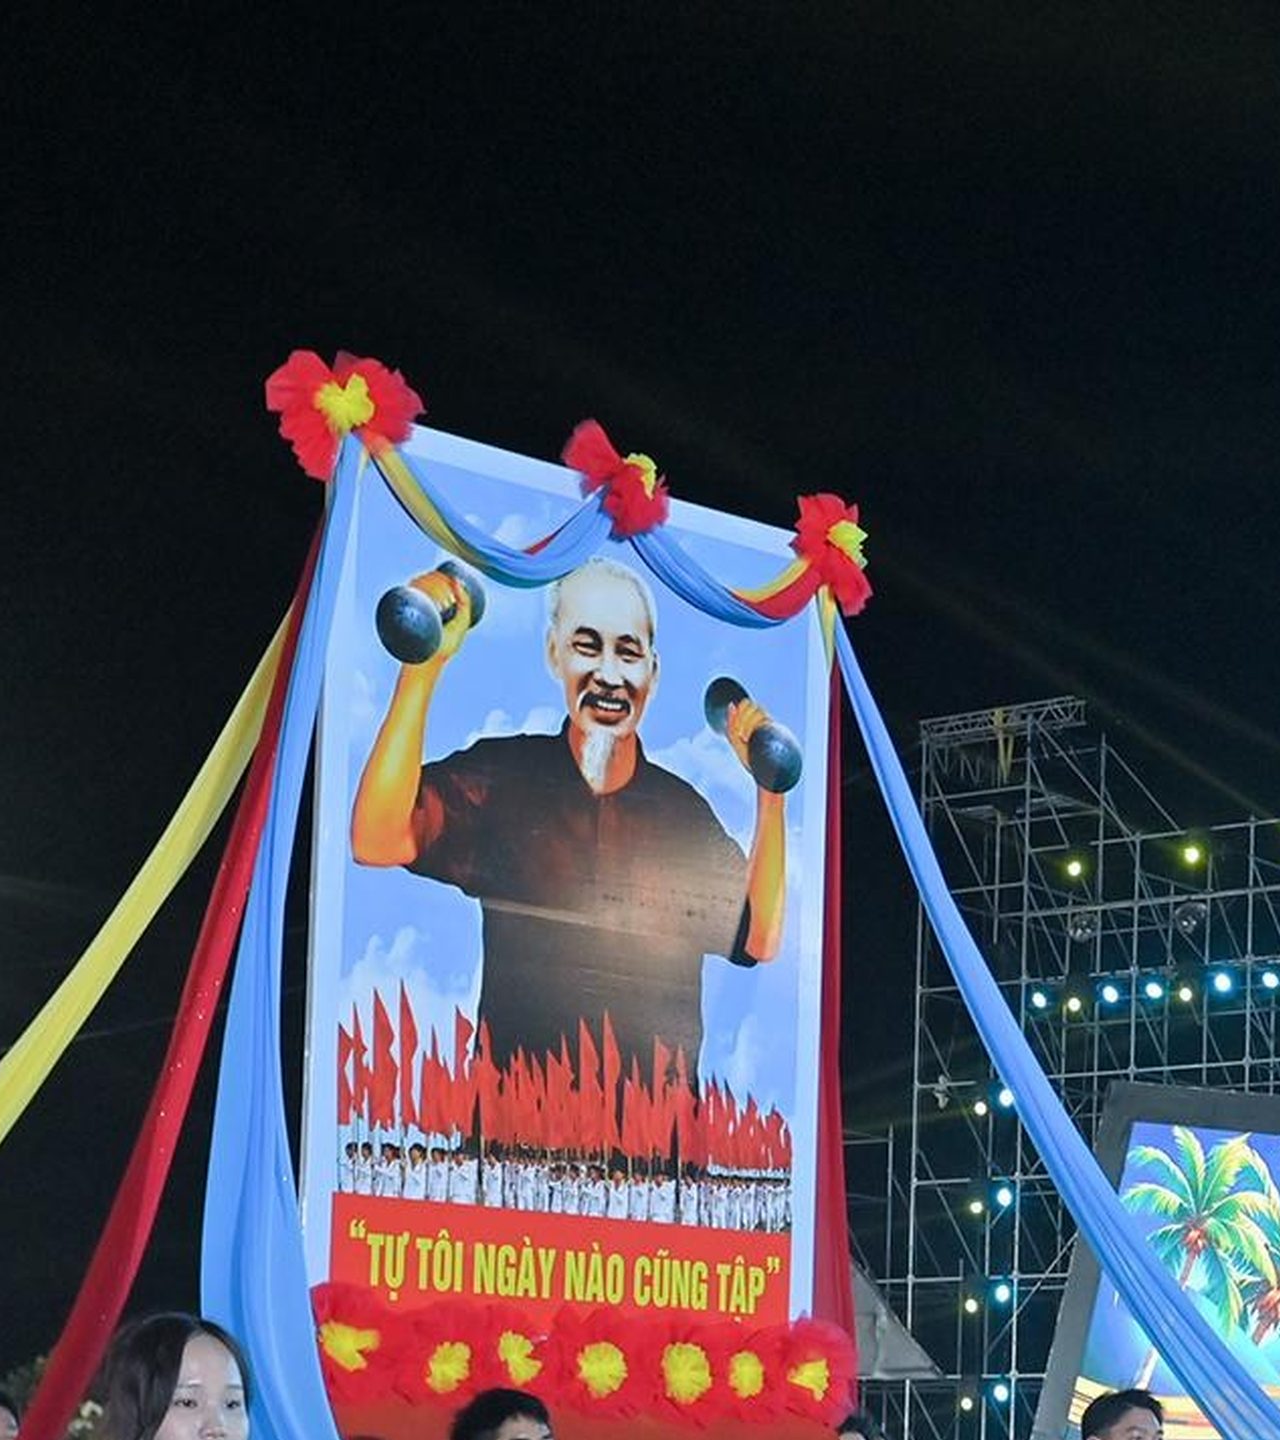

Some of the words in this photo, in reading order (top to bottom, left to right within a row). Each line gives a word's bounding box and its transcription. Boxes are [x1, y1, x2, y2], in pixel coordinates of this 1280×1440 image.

[416, 1228, 464, 1292] TÔI
[473, 1236, 557, 1299] NGÀY
[564, 1242, 625, 1305] NÀO
[633, 1249, 709, 1311] CŨNG
